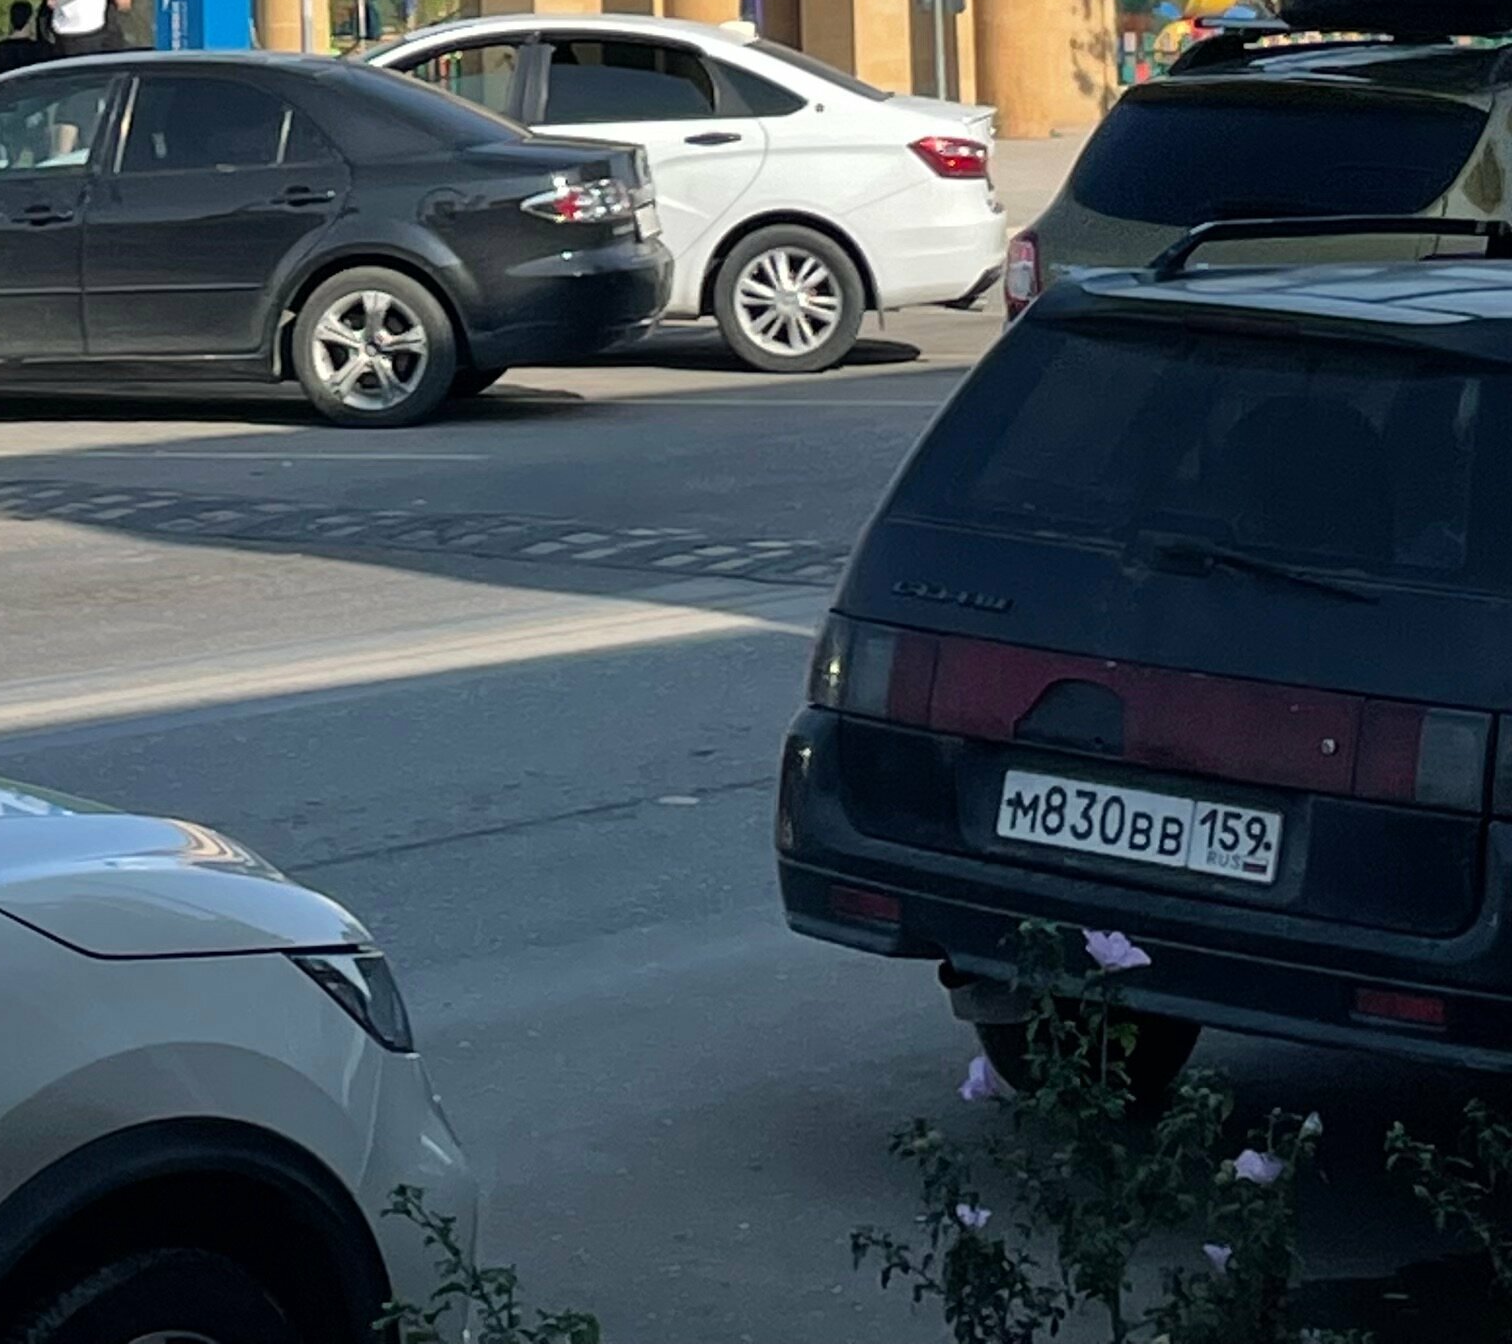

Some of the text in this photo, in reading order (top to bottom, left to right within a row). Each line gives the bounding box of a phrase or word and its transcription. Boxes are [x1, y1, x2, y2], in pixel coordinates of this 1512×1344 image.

[1009, 785, 1267, 857] М830ВВ 159
[1206, 851, 1241, 871] RUS
